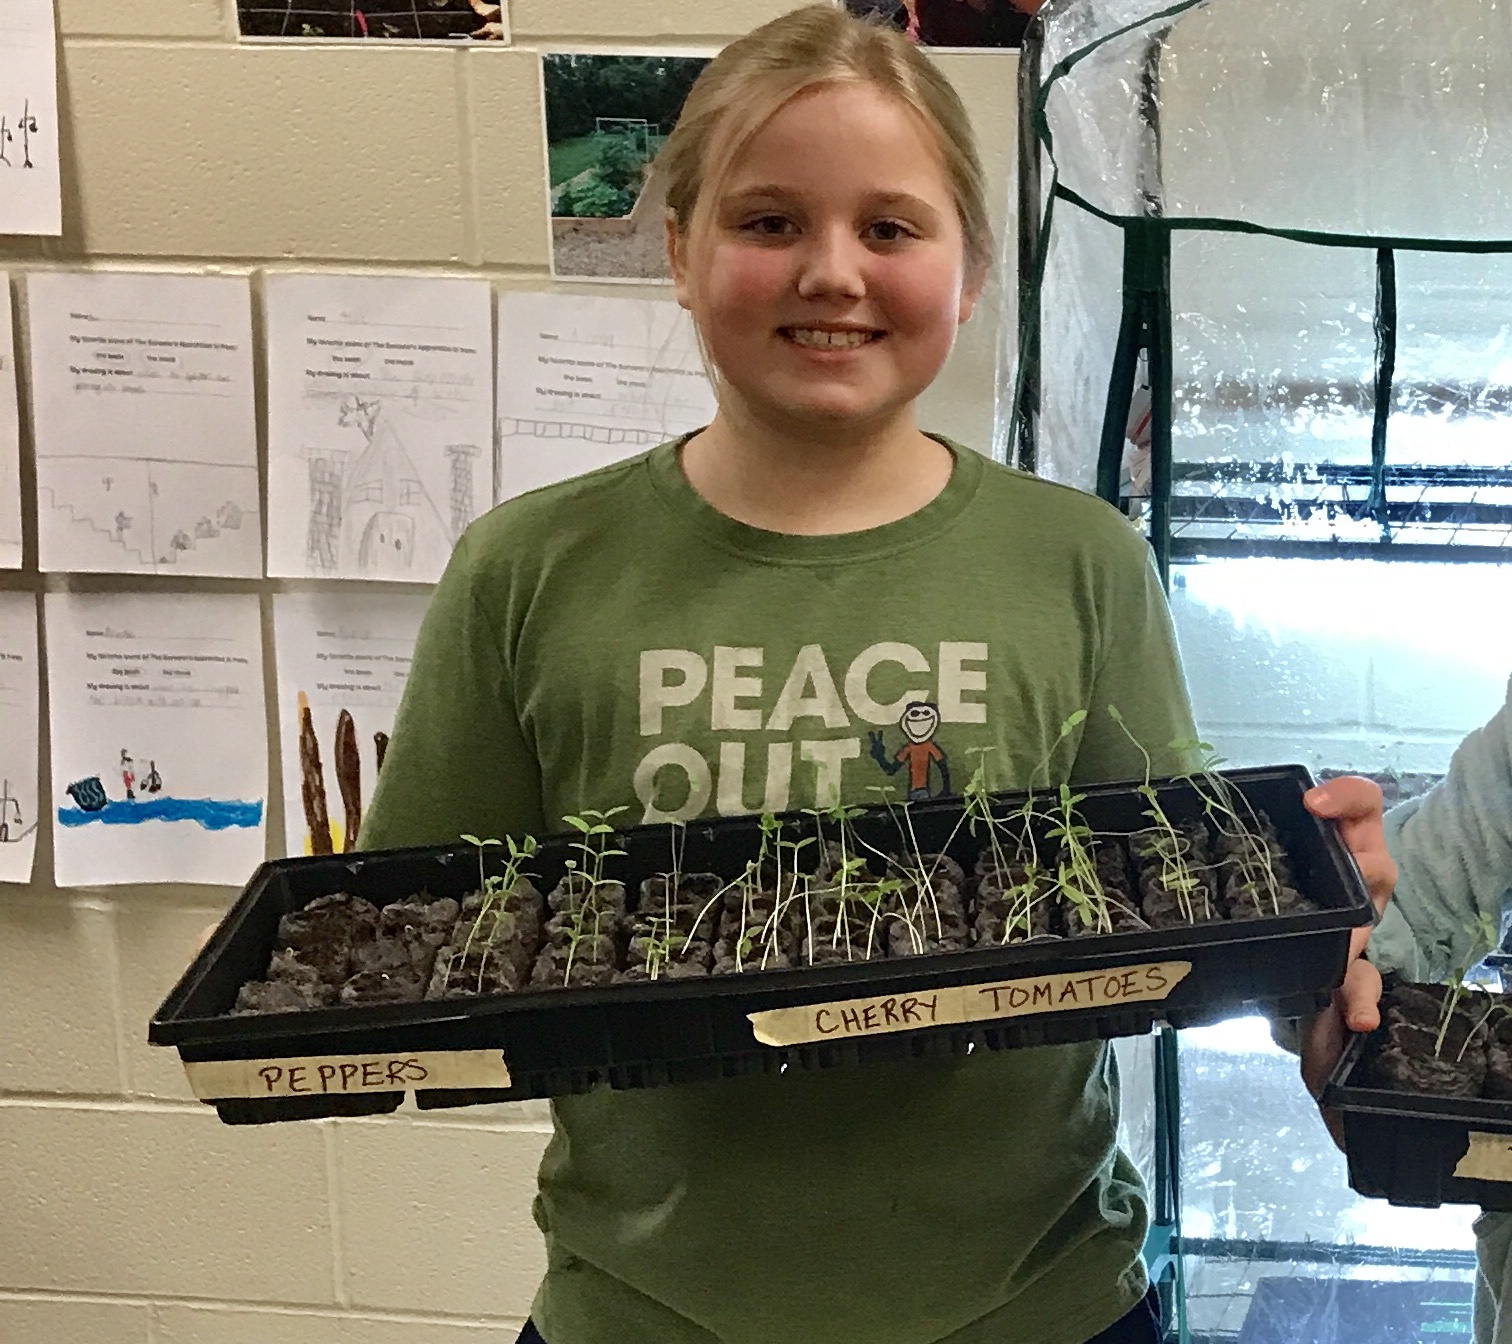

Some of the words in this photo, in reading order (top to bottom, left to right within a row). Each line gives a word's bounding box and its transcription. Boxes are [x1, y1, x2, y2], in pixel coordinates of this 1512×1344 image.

[639, 641, 989, 736] PEACE
[633, 737, 861, 826] OUT
[814, 994, 938, 1035] CHERRY
[978, 966, 1168, 1013] TOMATOES
[258, 1058, 429, 1092] PEPPERS
